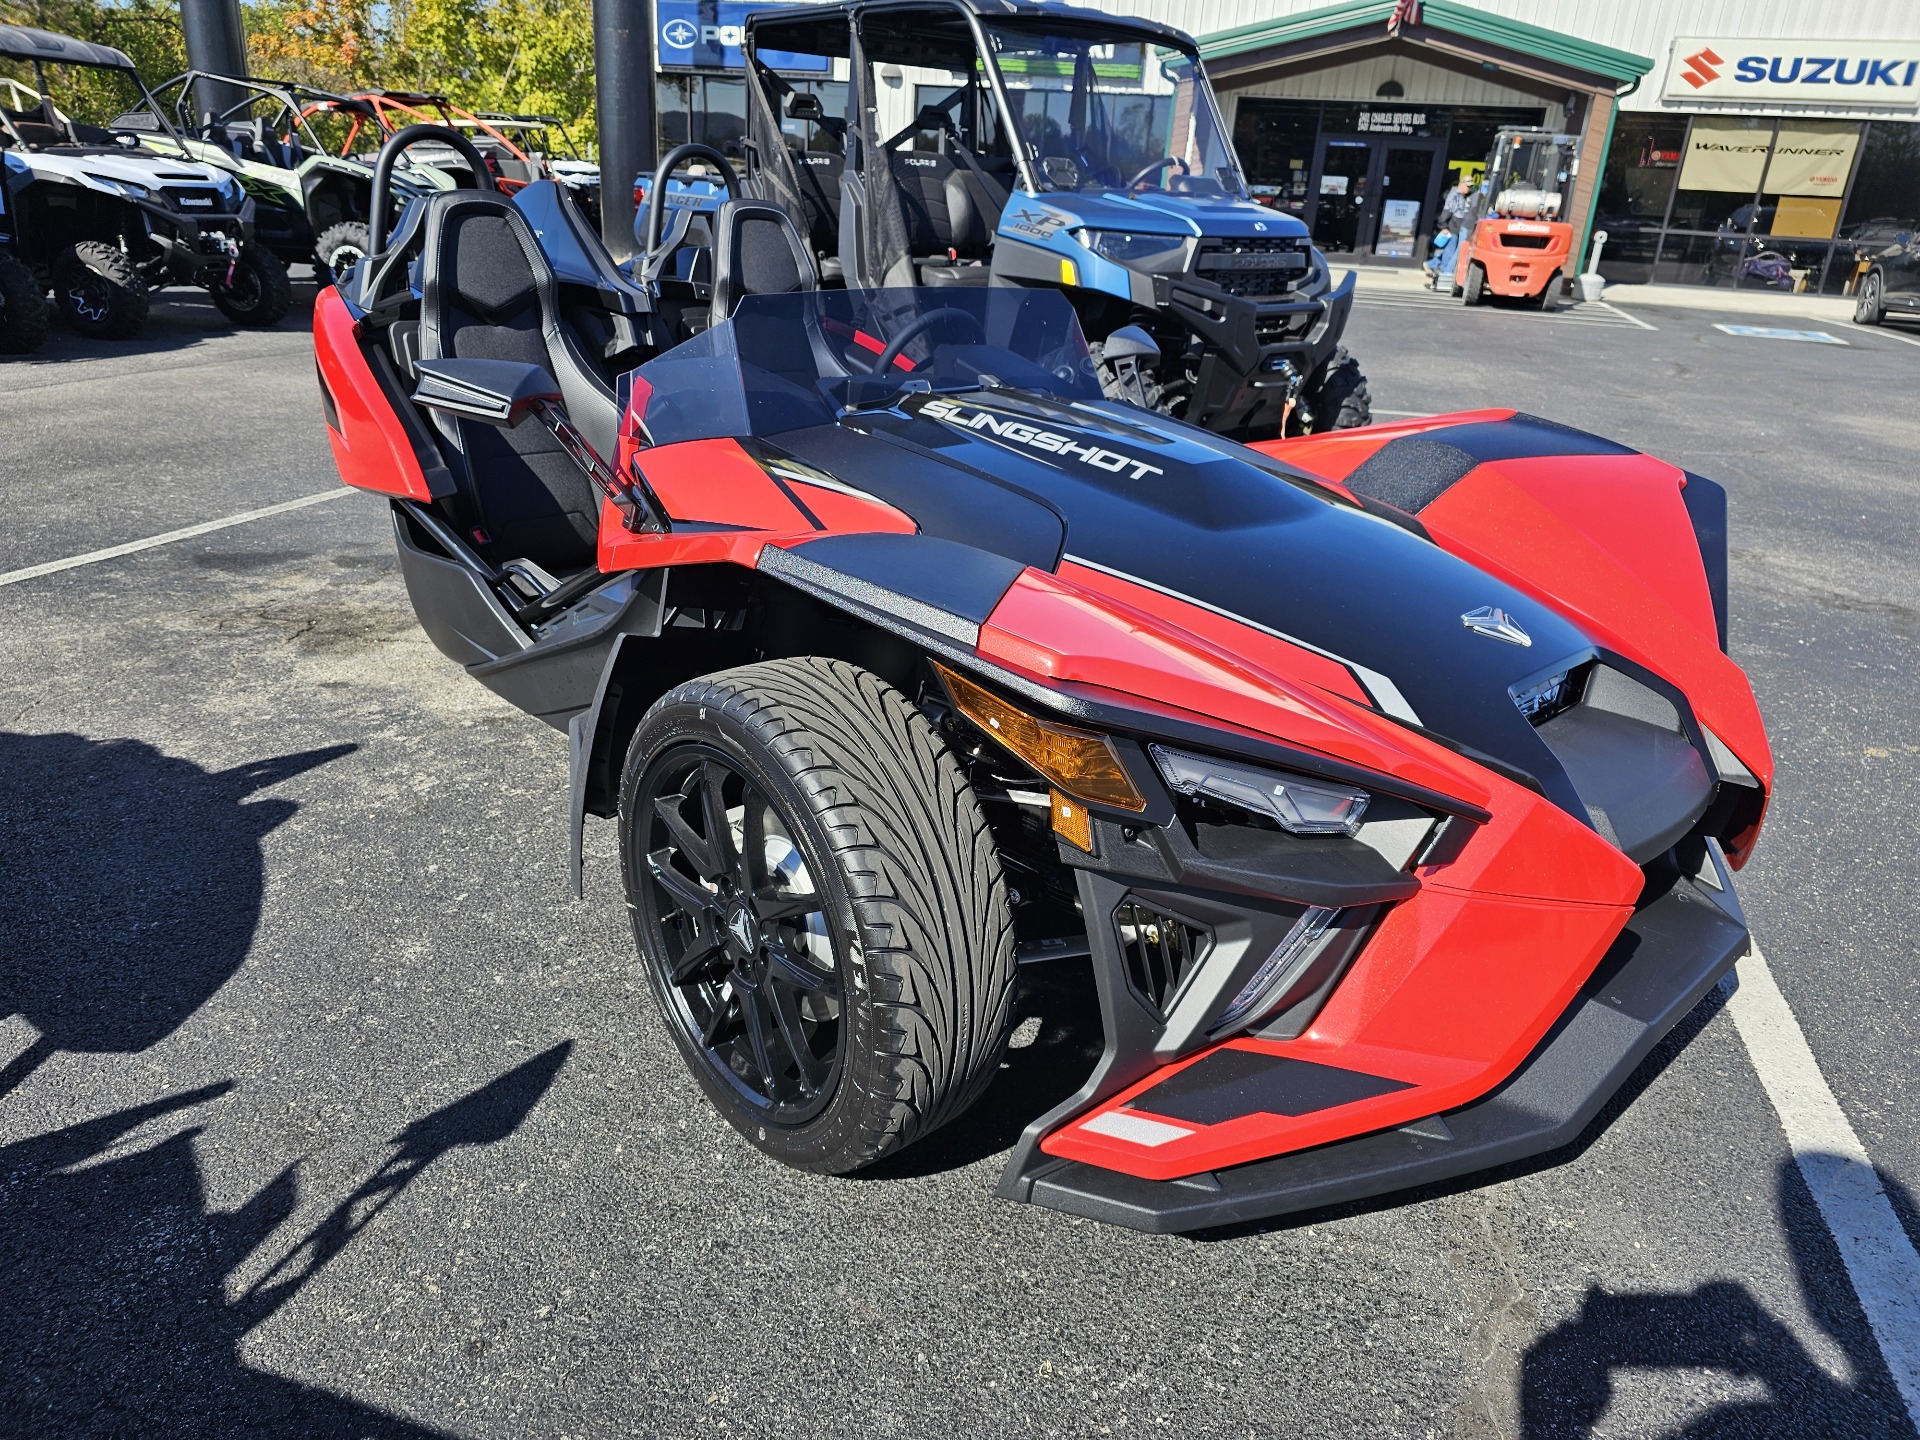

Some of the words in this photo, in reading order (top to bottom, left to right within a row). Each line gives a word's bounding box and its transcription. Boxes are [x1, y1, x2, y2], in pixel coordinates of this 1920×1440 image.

[1734, 56, 1919, 86] SUZUKI
[1010, 208, 1066, 227] XP
[1014, 223, 1053, 239] 1000
[1234, 256, 1288, 268] POLARIS
[918, 400, 1164, 481] SLINGSHOT
